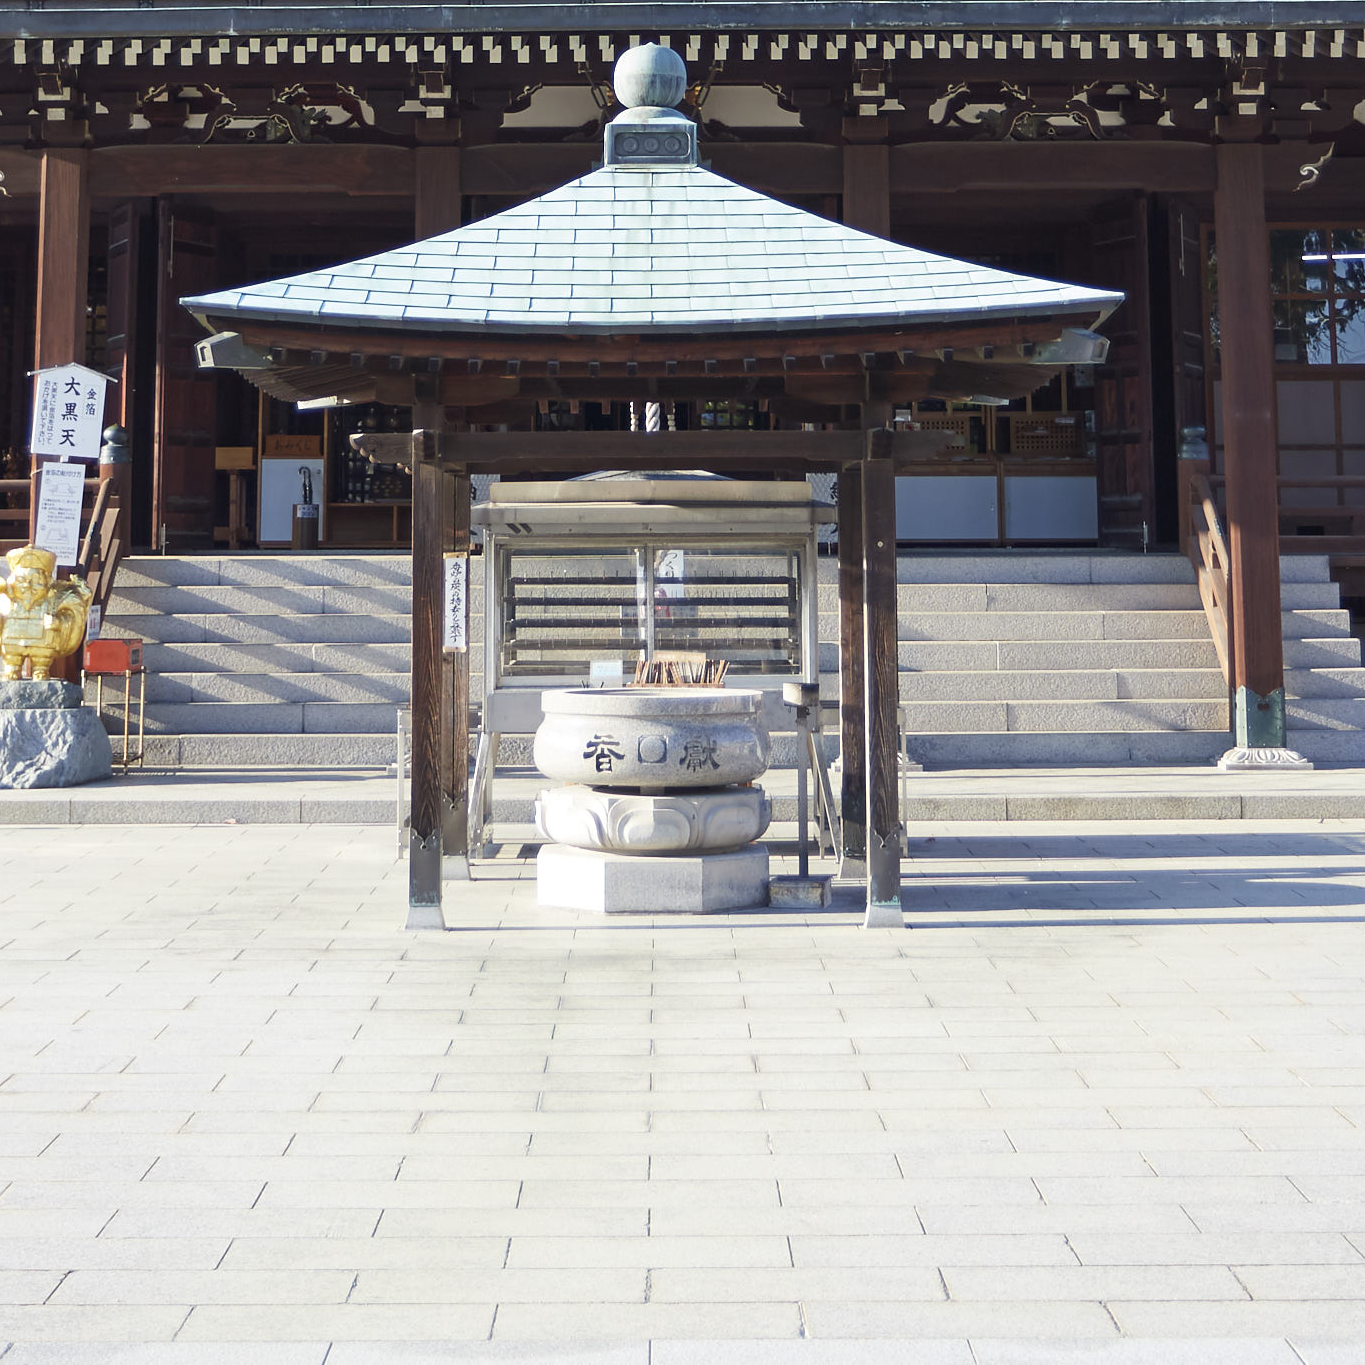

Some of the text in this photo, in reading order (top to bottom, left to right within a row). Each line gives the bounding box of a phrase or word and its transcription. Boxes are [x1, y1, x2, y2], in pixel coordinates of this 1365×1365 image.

[59, 377, 81, 447] 大黒天
[86, 388, 97, 416] 金箔
[583, 734, 626, 772] 香
